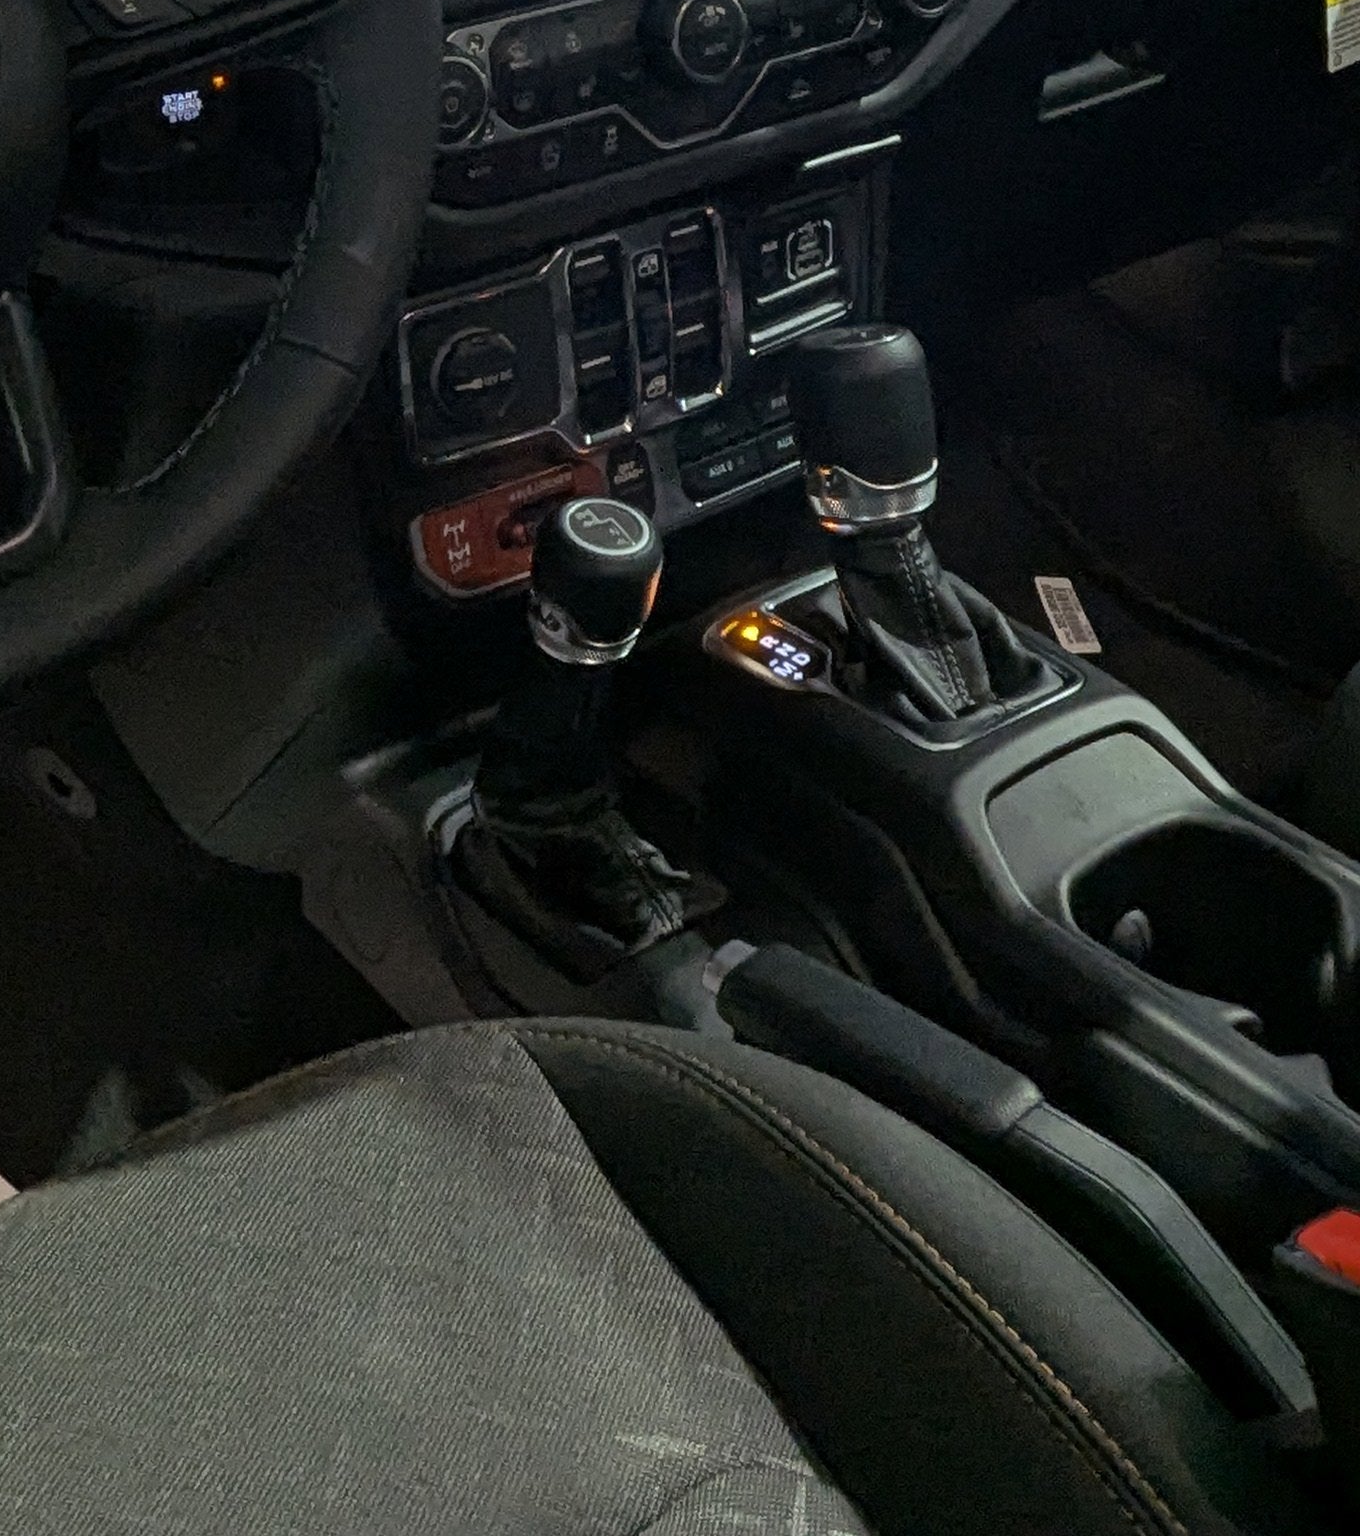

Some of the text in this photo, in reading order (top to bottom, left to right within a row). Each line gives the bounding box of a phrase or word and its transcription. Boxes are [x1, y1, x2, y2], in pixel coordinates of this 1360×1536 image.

[163, 90, 200, 105] START
[168, 110, 200, 124] STOP
[759, 635, 779, 649] R
[774, 642, 797, 658] N
[791, 652, 811, 667] D
